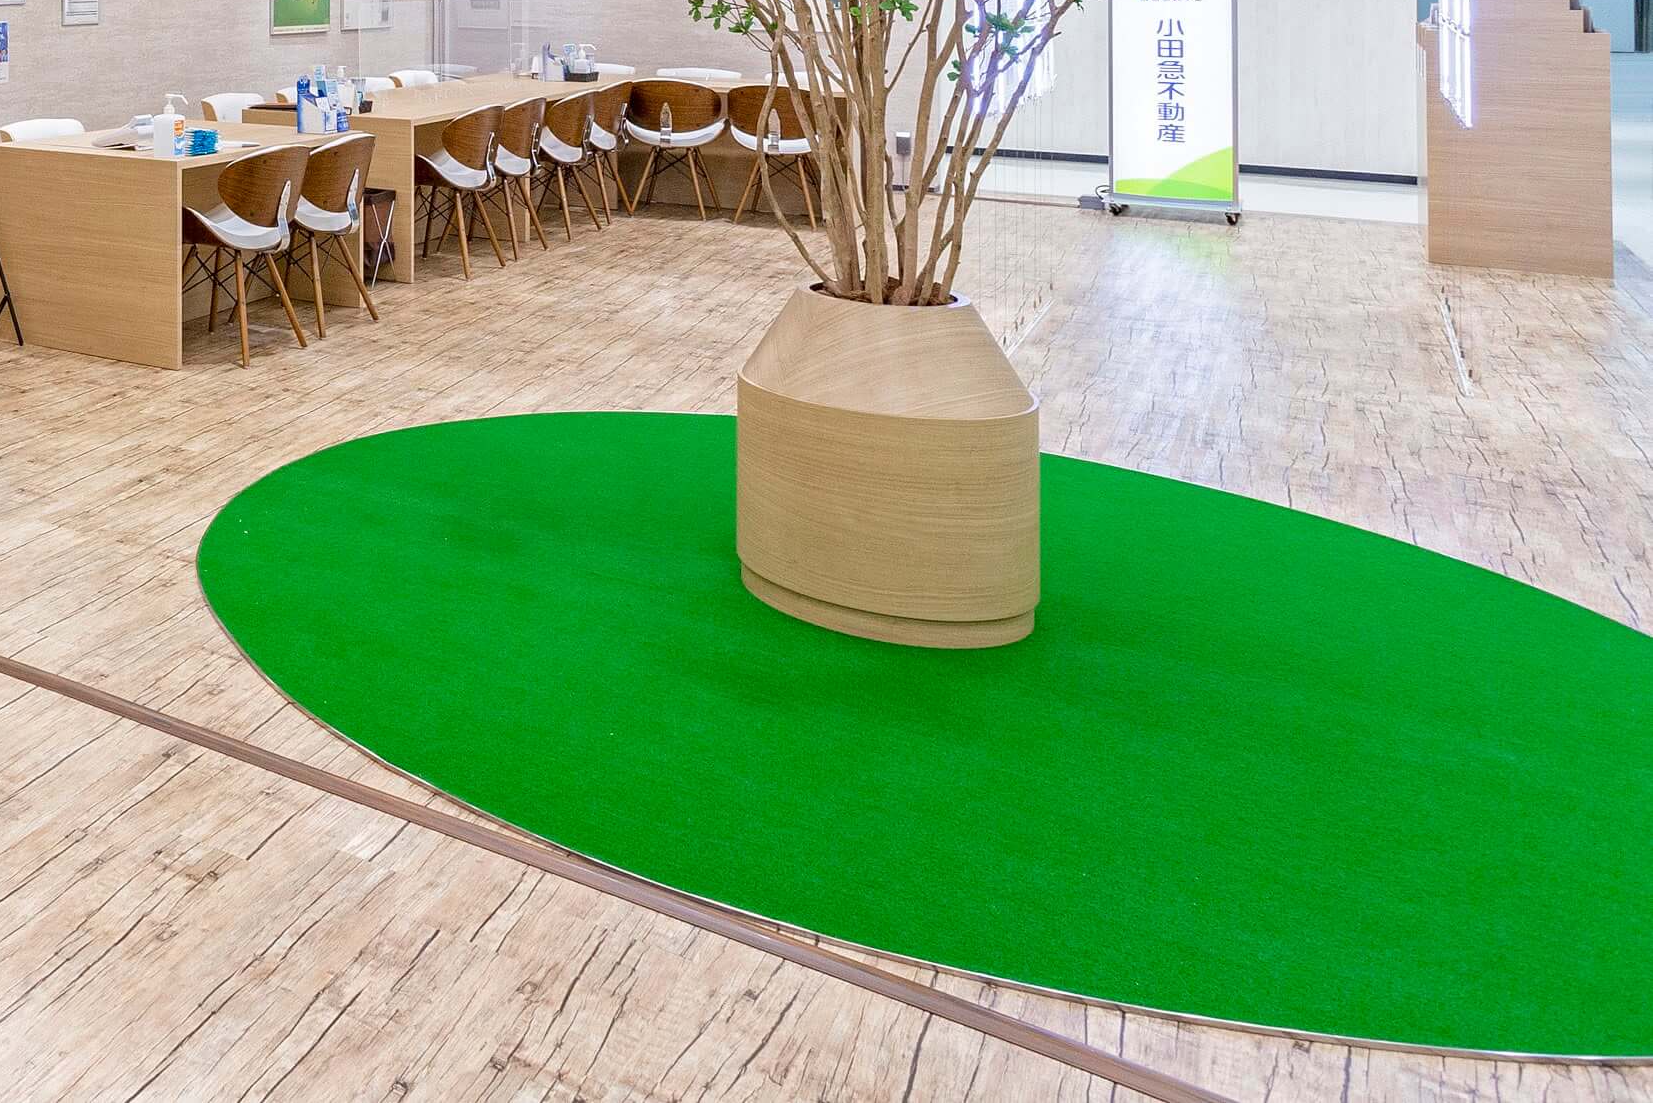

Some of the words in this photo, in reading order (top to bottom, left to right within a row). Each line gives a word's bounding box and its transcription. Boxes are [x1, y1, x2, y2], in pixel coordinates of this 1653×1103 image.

[1157, 18, 1185, 143] 小田急不動産
